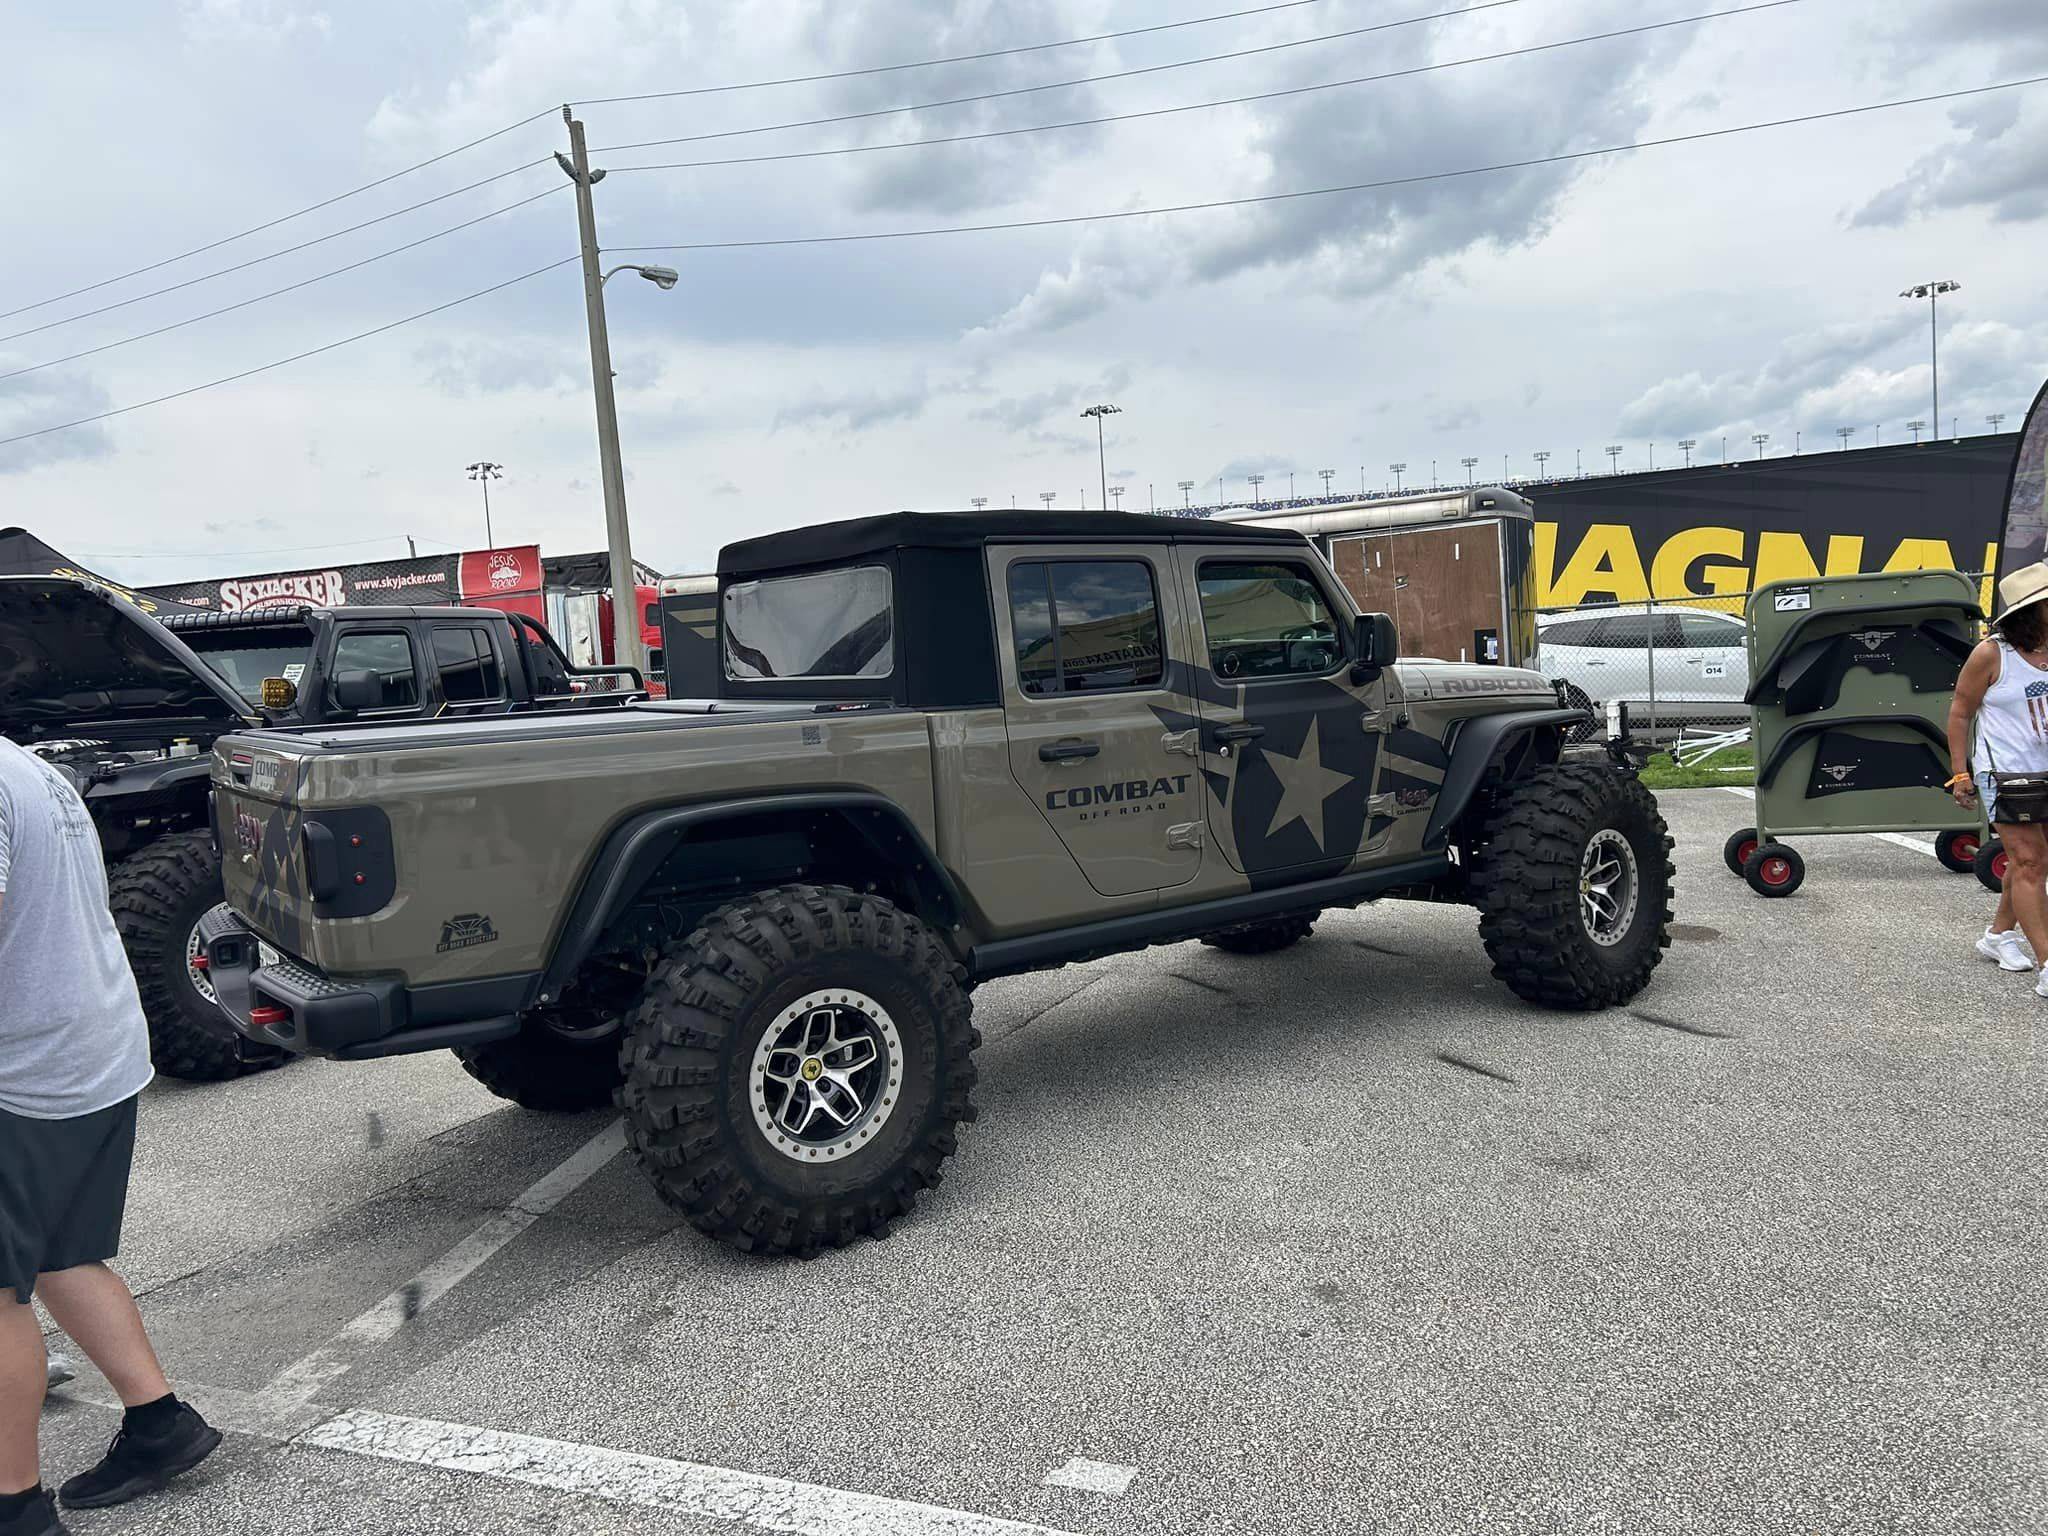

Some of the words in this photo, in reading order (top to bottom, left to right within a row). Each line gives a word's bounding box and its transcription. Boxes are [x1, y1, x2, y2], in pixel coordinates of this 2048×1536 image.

[490, 554, 515, 568] JESUS
[354, 572, 446, 591] www.skyjacker.com
[219, 571, 346, 612] SKYJACKER
[1443, 679, 1549, 693] RUBICON
[1046, 774, 1192, 810] COMBAT
[1080, 810, 1113, 821] OFF
[1119, 802, 1167, 815] ROAD
